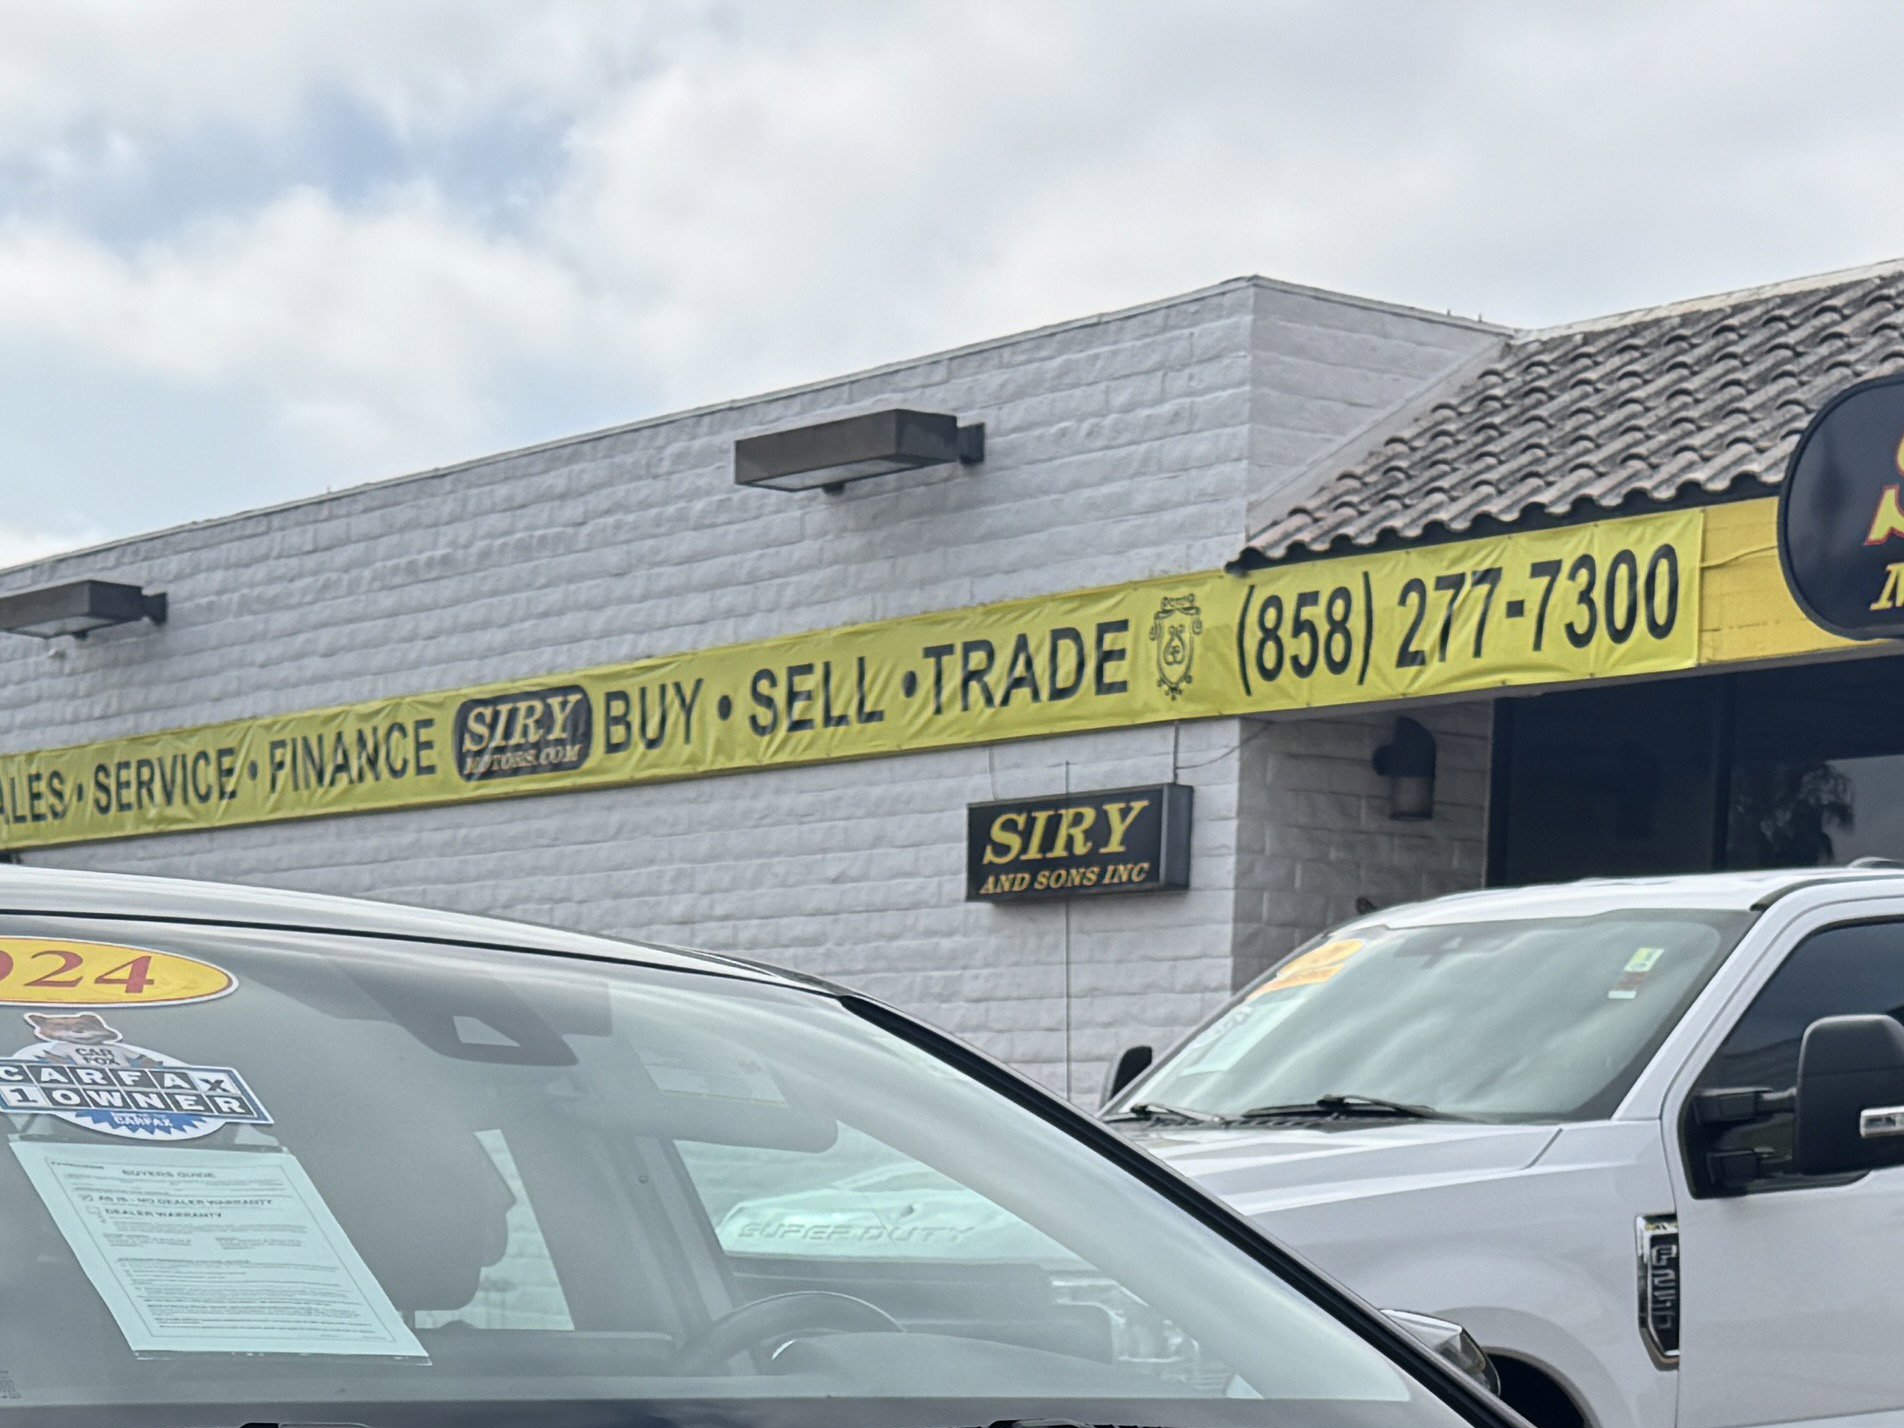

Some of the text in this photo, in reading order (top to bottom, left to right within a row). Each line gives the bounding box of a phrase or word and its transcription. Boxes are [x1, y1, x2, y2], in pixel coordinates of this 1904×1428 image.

[1237, 543, 1679, 697] (858) 277-7300
[603, 618, 1130, 755] BUY SELL TRADE
[462, 693, 581, 752] SIRY
[93, 747, 237, 816] SERVICE
[269, 717, 436, 794] FINANCE
[463, 743, 583, 776] MOTORS.COM
[983, 800, 1150, 865] SIRY
[979, 862, 1150, 895] AND SONS INC
[8, 1087, 246, 1113] 1 OWNER
[738, 1222, 974, 1243] SUPER DUTY
